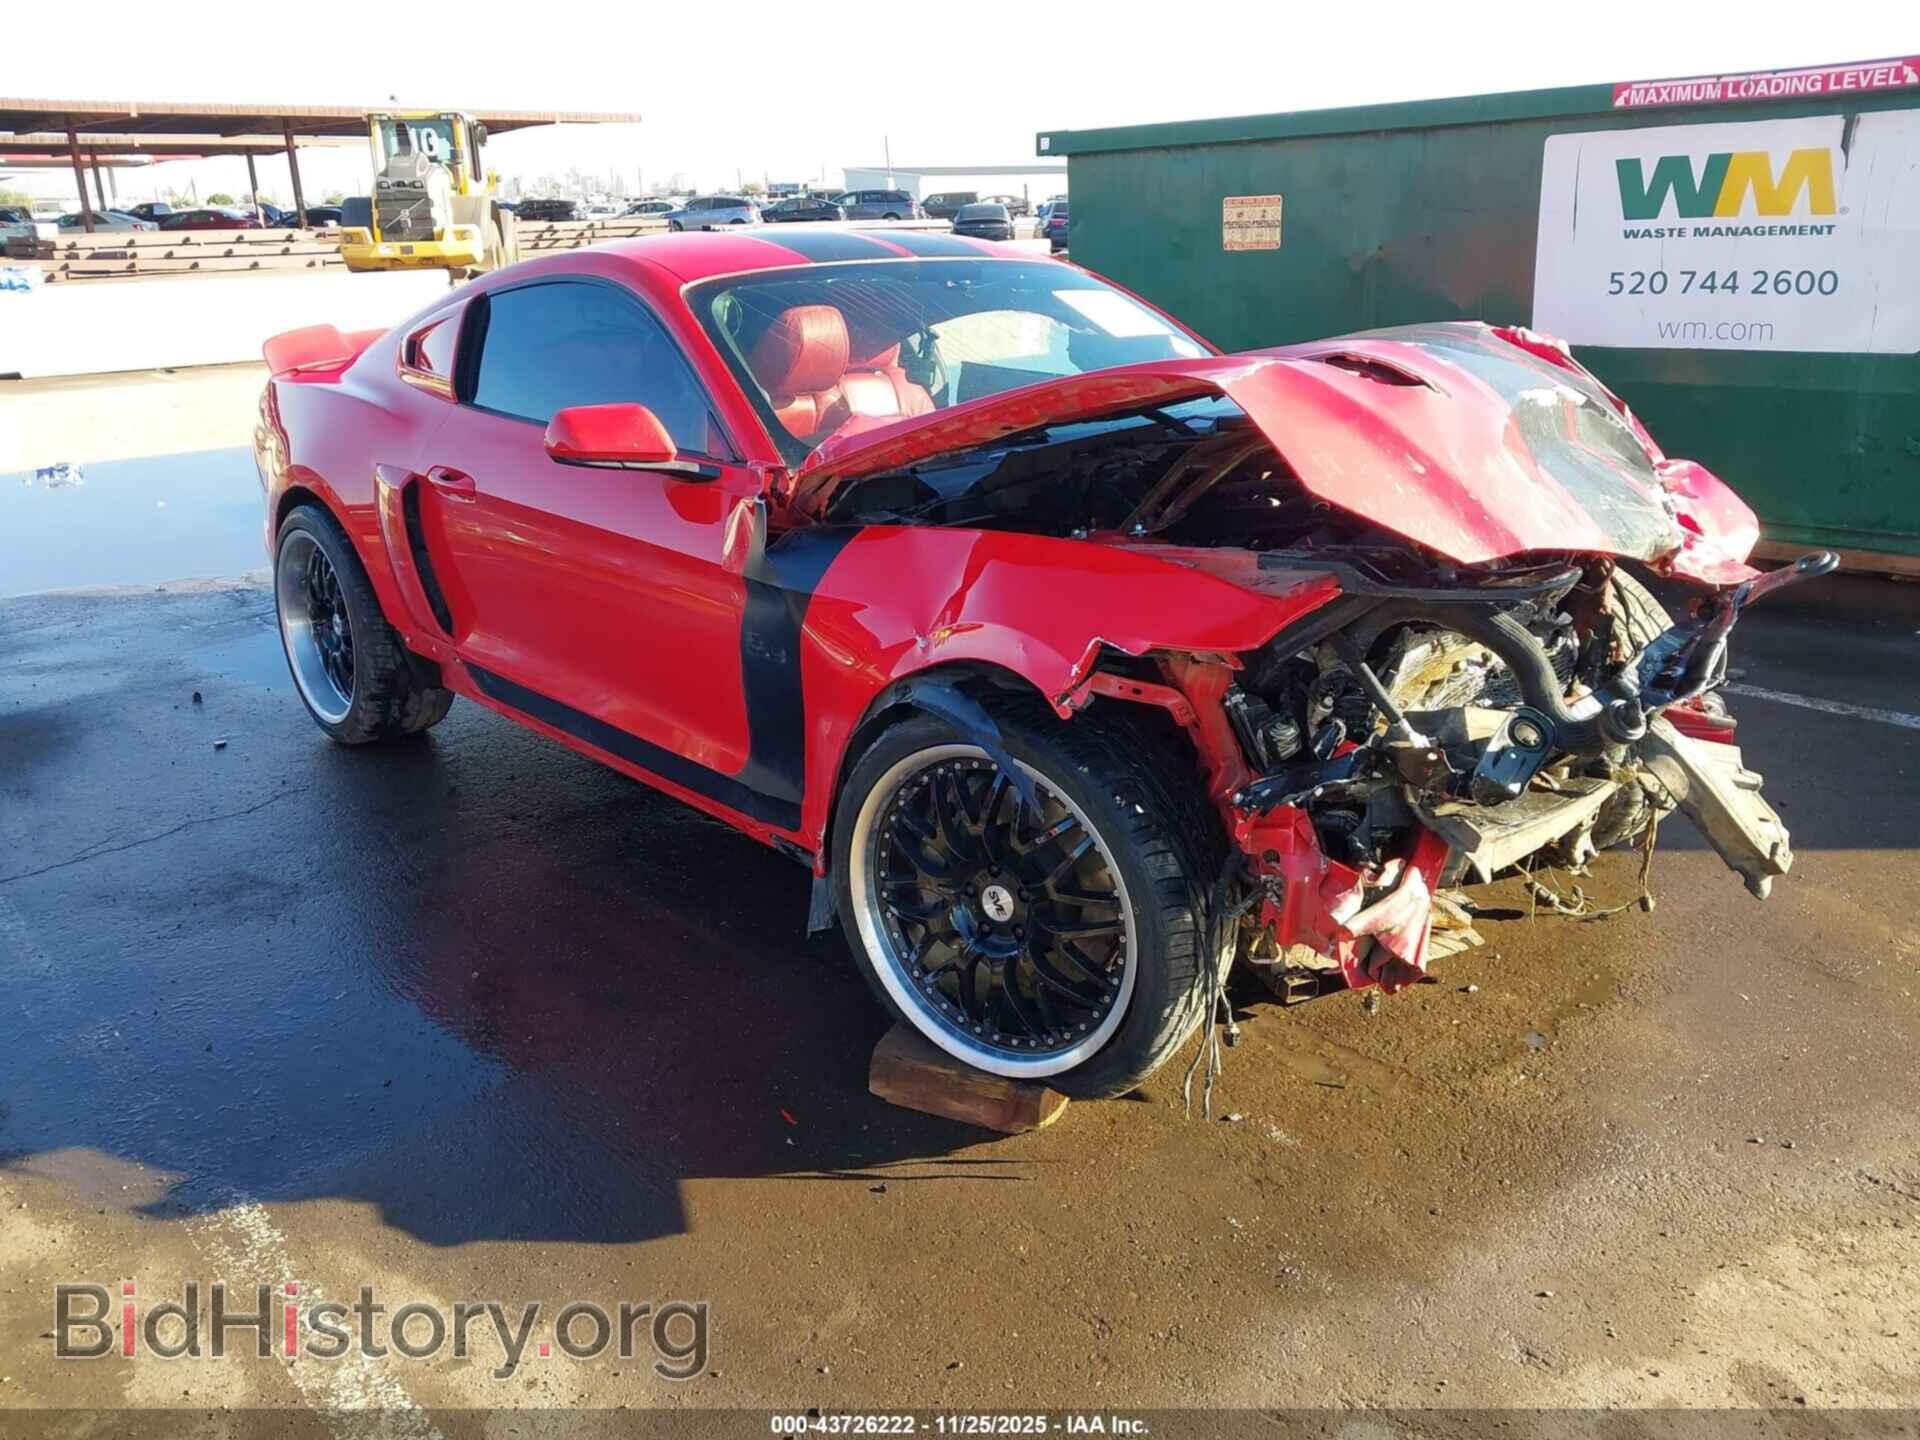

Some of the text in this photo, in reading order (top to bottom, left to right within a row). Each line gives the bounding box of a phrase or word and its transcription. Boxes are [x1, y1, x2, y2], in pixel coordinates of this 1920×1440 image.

[1629, 66, 1901, 105] MAXIMUM LOADING LEVEL
[1616, 148, 1837, 221] WM
[1623, 224, 1837, 240] WASTE MANAGEMENT
[1608, 270, 1839, 296] 520 744 2600
[1657, 321, 1774, 342] wm.com
